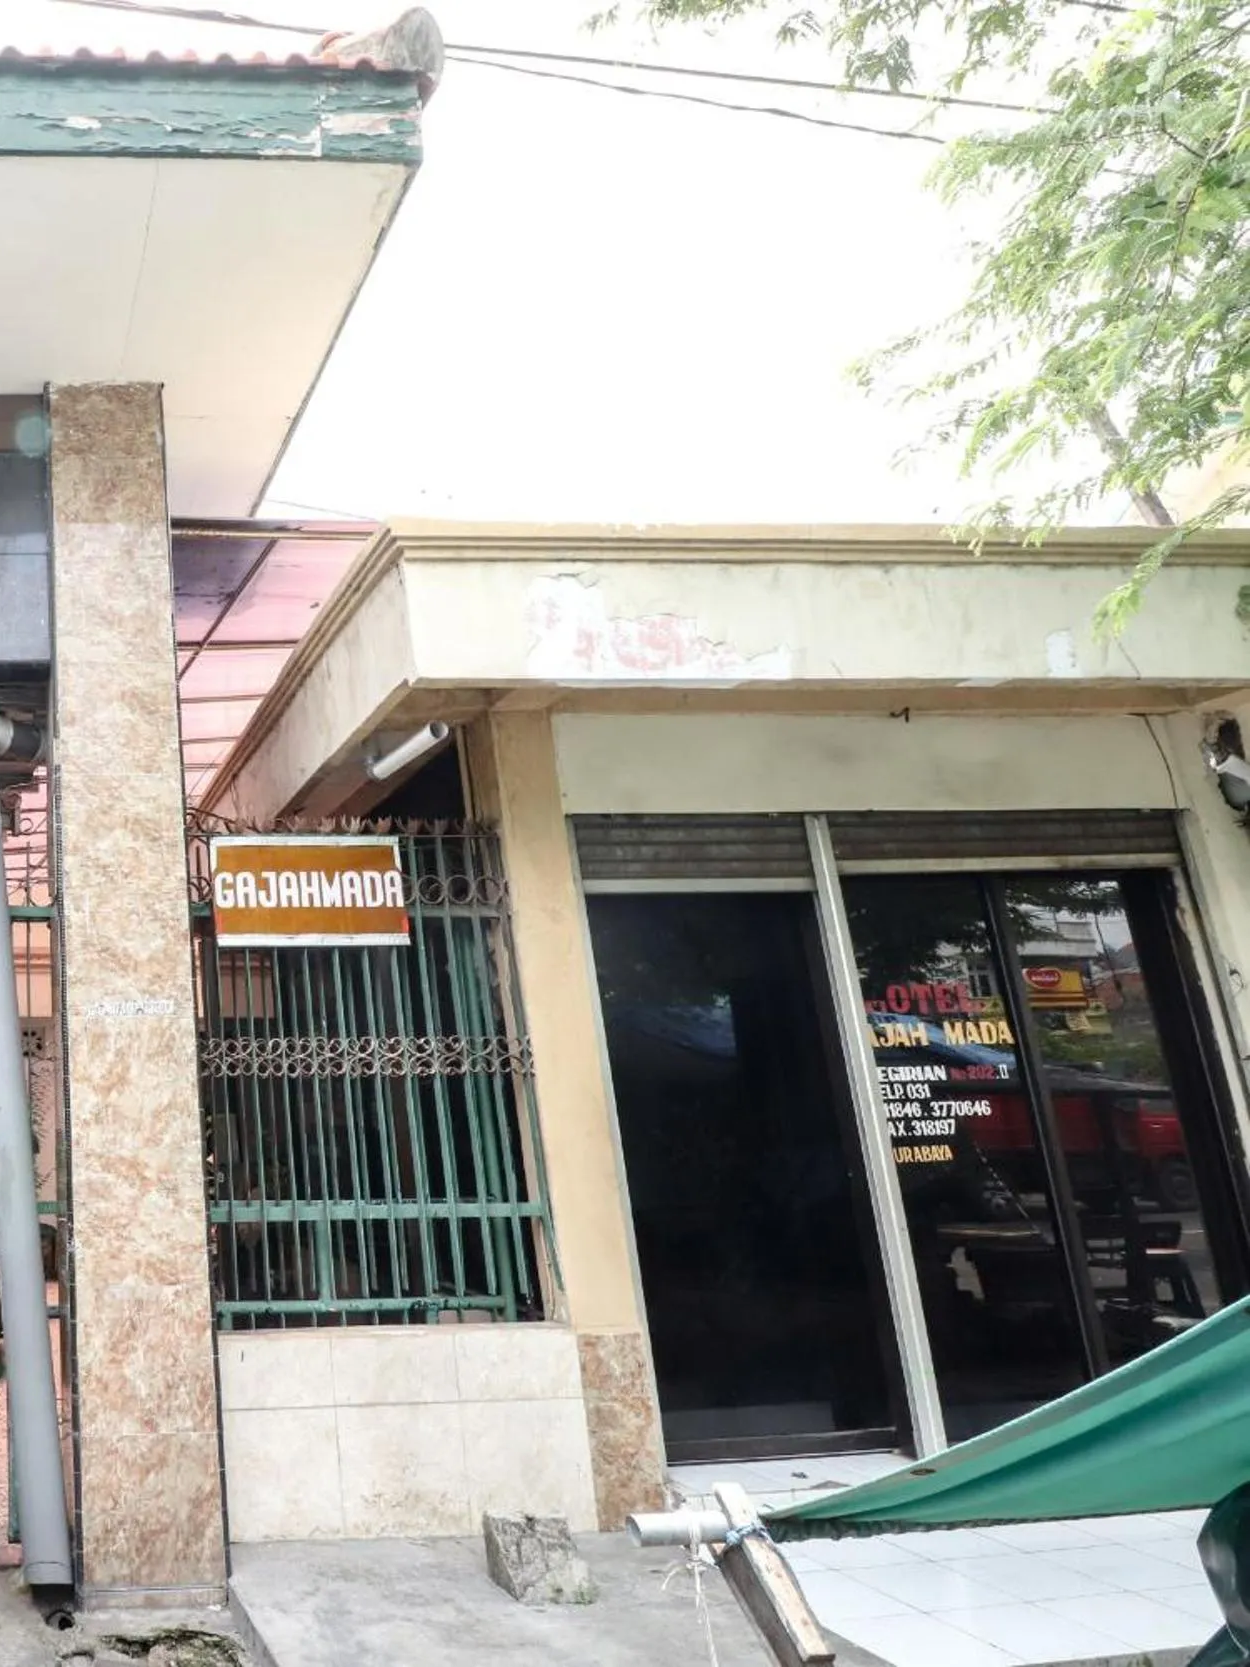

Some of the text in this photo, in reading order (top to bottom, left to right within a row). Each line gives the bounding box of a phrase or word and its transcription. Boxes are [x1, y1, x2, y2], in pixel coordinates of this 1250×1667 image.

[214, 870, 405, 909] GAJAHMADA
[867, 982, 978, 1015] OTEL
[867, 1020, 1015, 1048] AJAH MADA
[877, 1065, 947, 1082] EGIRIAN
[892, 1145, 954, 1163] URABAYA
